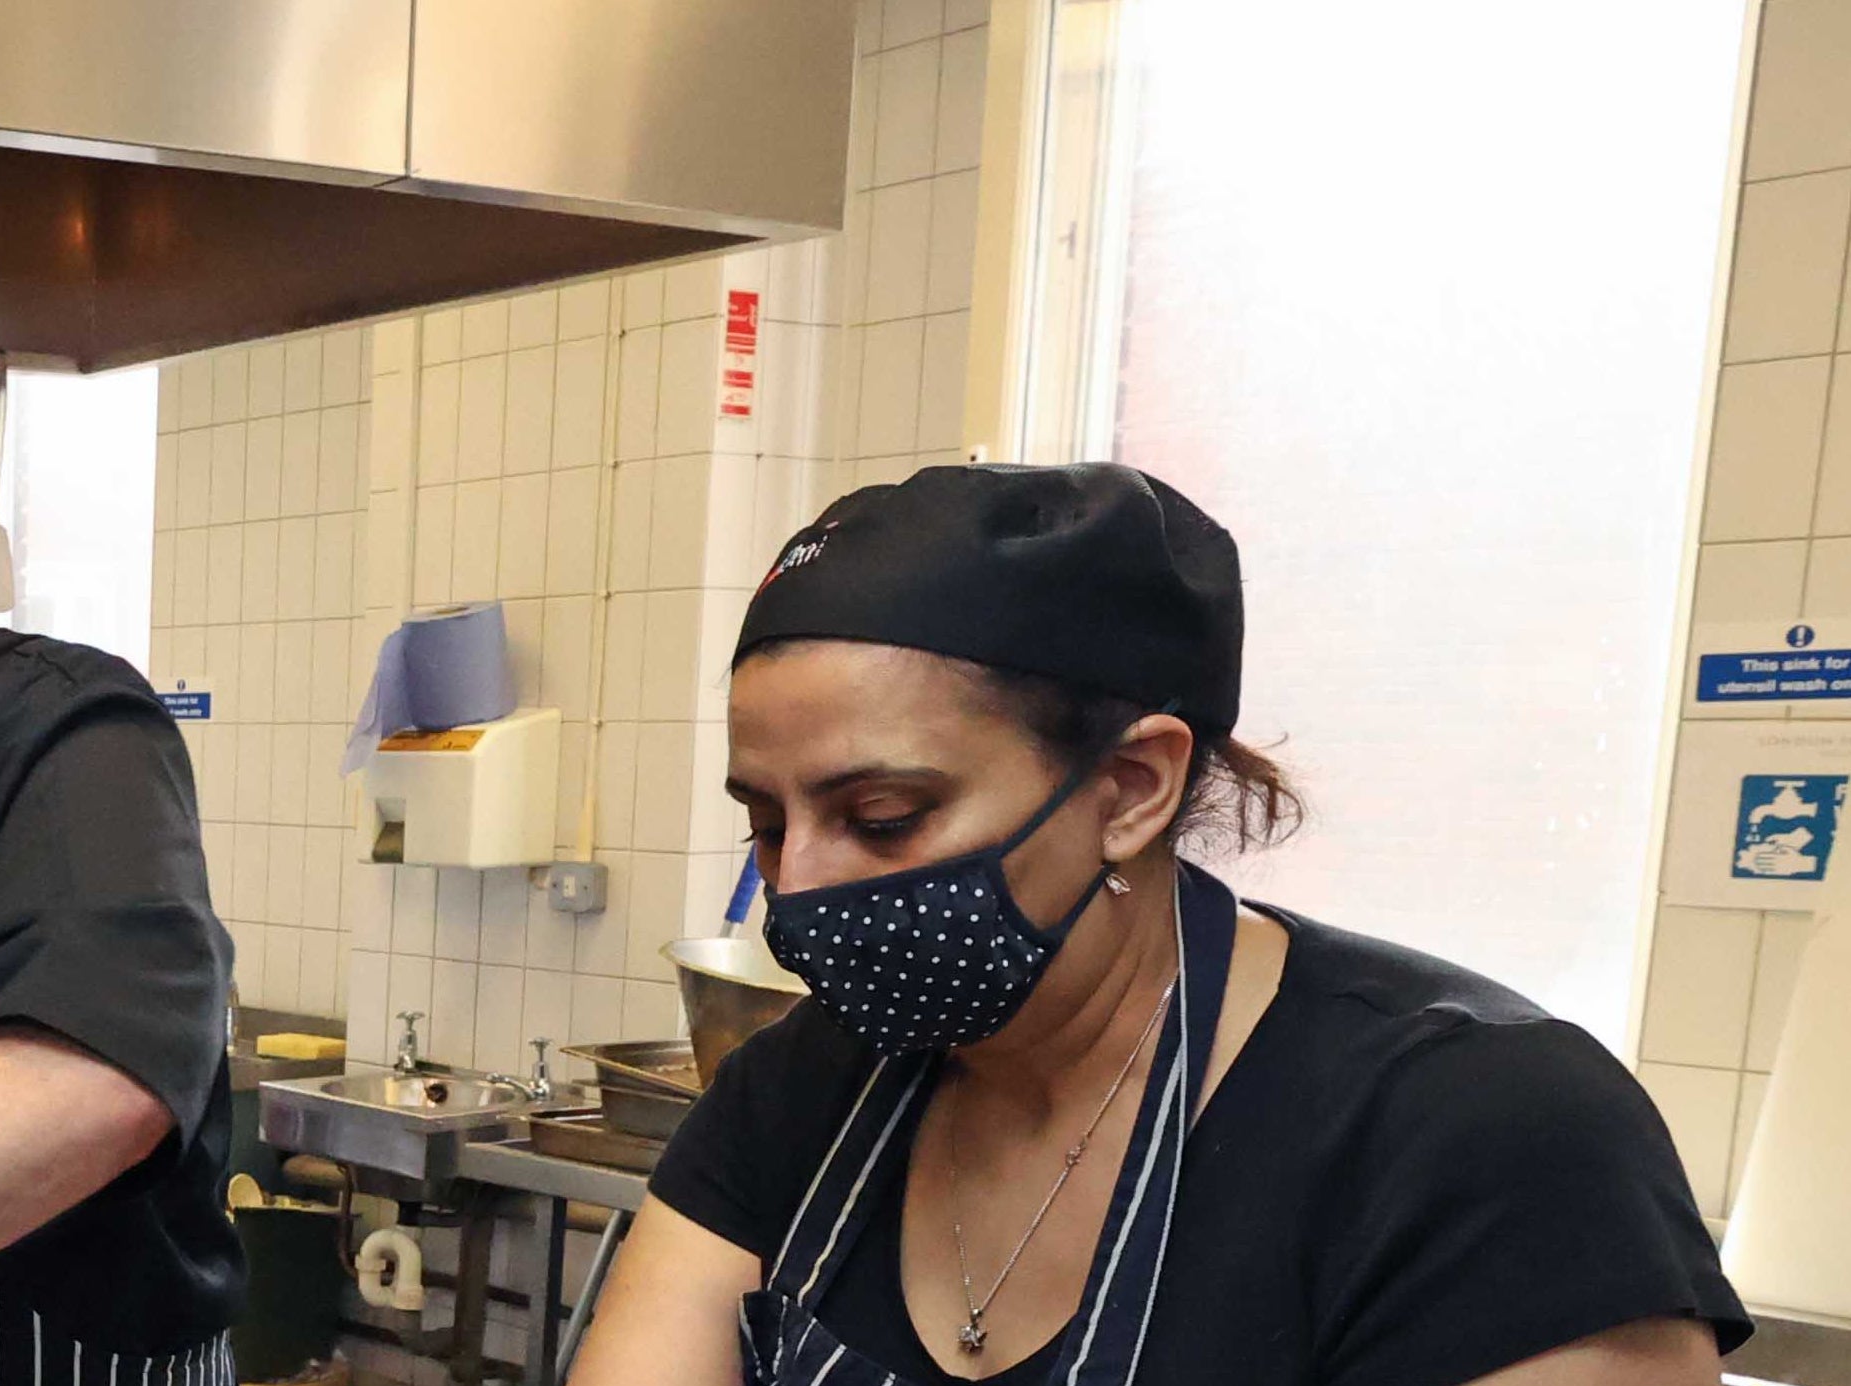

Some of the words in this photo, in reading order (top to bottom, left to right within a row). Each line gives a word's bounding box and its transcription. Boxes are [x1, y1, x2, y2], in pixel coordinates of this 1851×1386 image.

[1741, 658, 1780, 672] This
[1783, 657, 1820, 671] sink
[1825, 656, 1850, 669] for
[1717, 680, 1777, 694] utensil
[1780, 678, 1827, 692] wash
